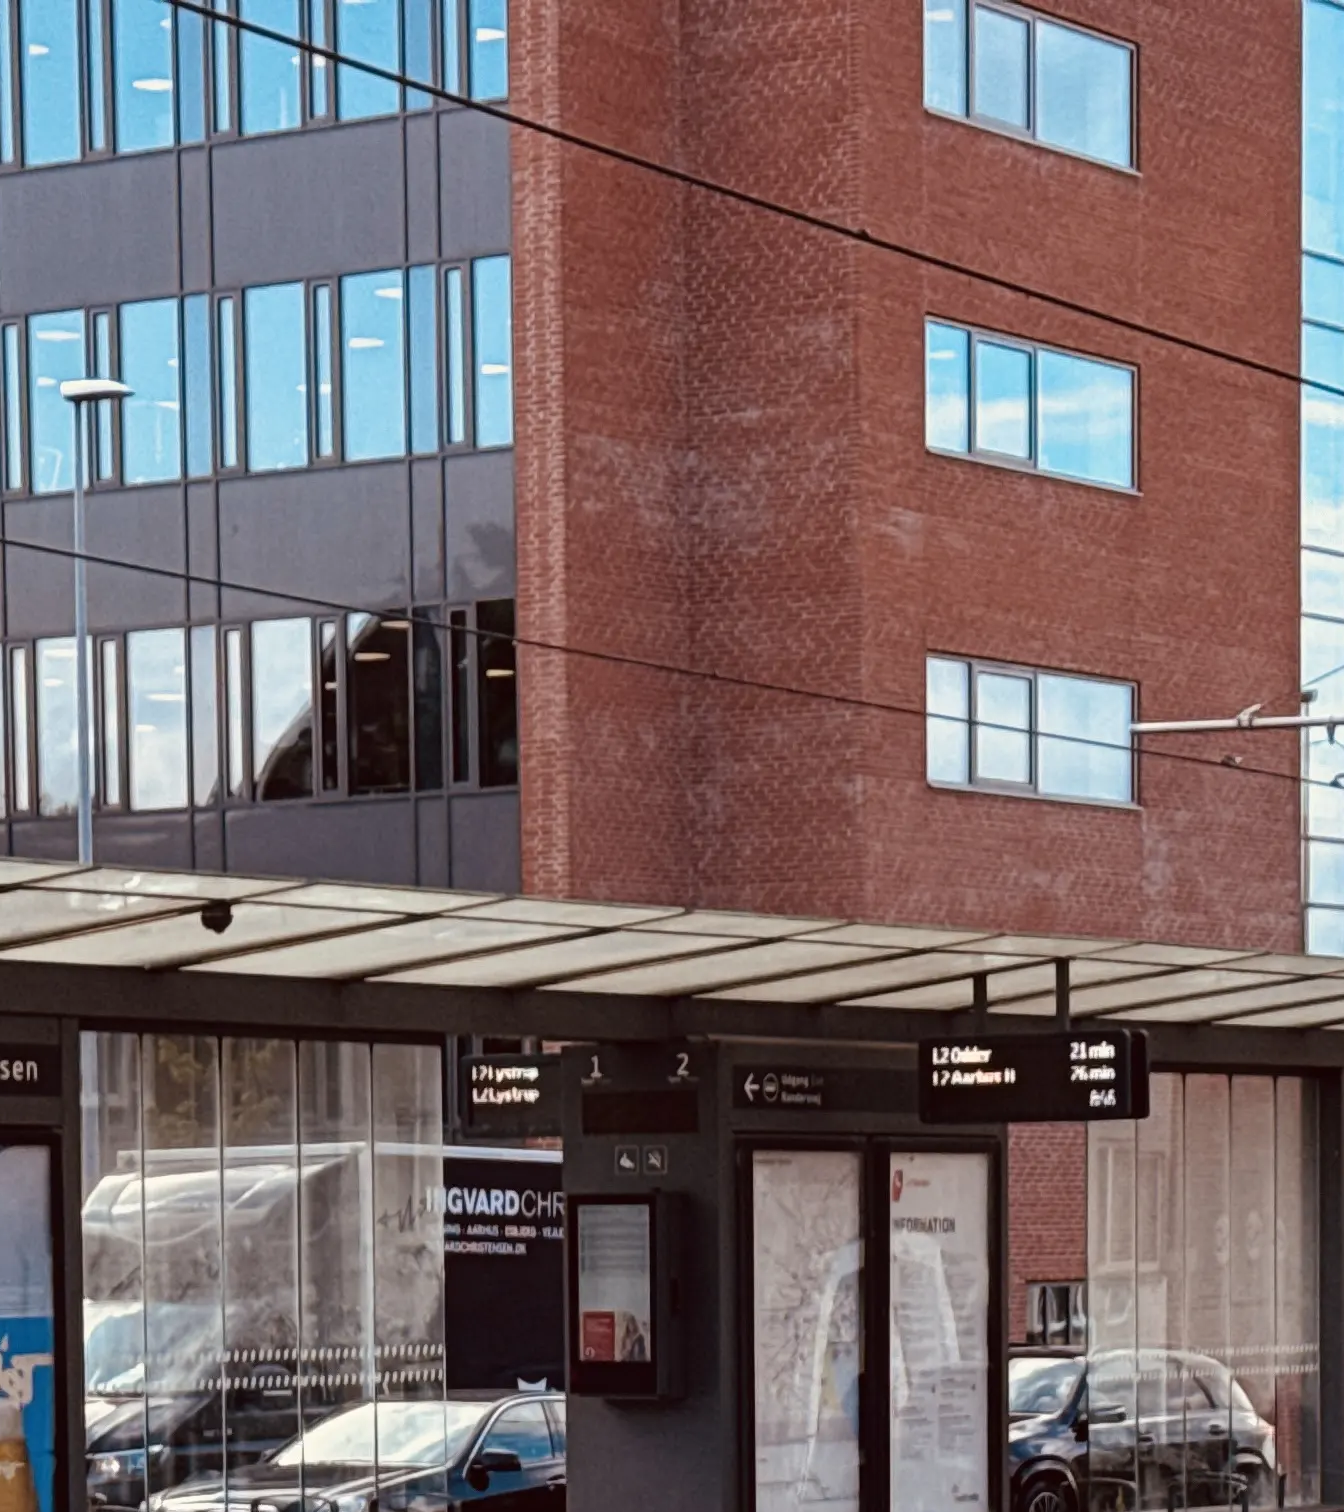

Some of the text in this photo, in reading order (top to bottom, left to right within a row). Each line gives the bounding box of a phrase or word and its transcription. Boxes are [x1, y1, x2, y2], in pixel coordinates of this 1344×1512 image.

[1088, 1041, 1116, 1059] min
[590, 1055, 603, 1078] 1
[676, 1052, 690, 1076] 2
[1088, 1064, 1117, 1081] min
